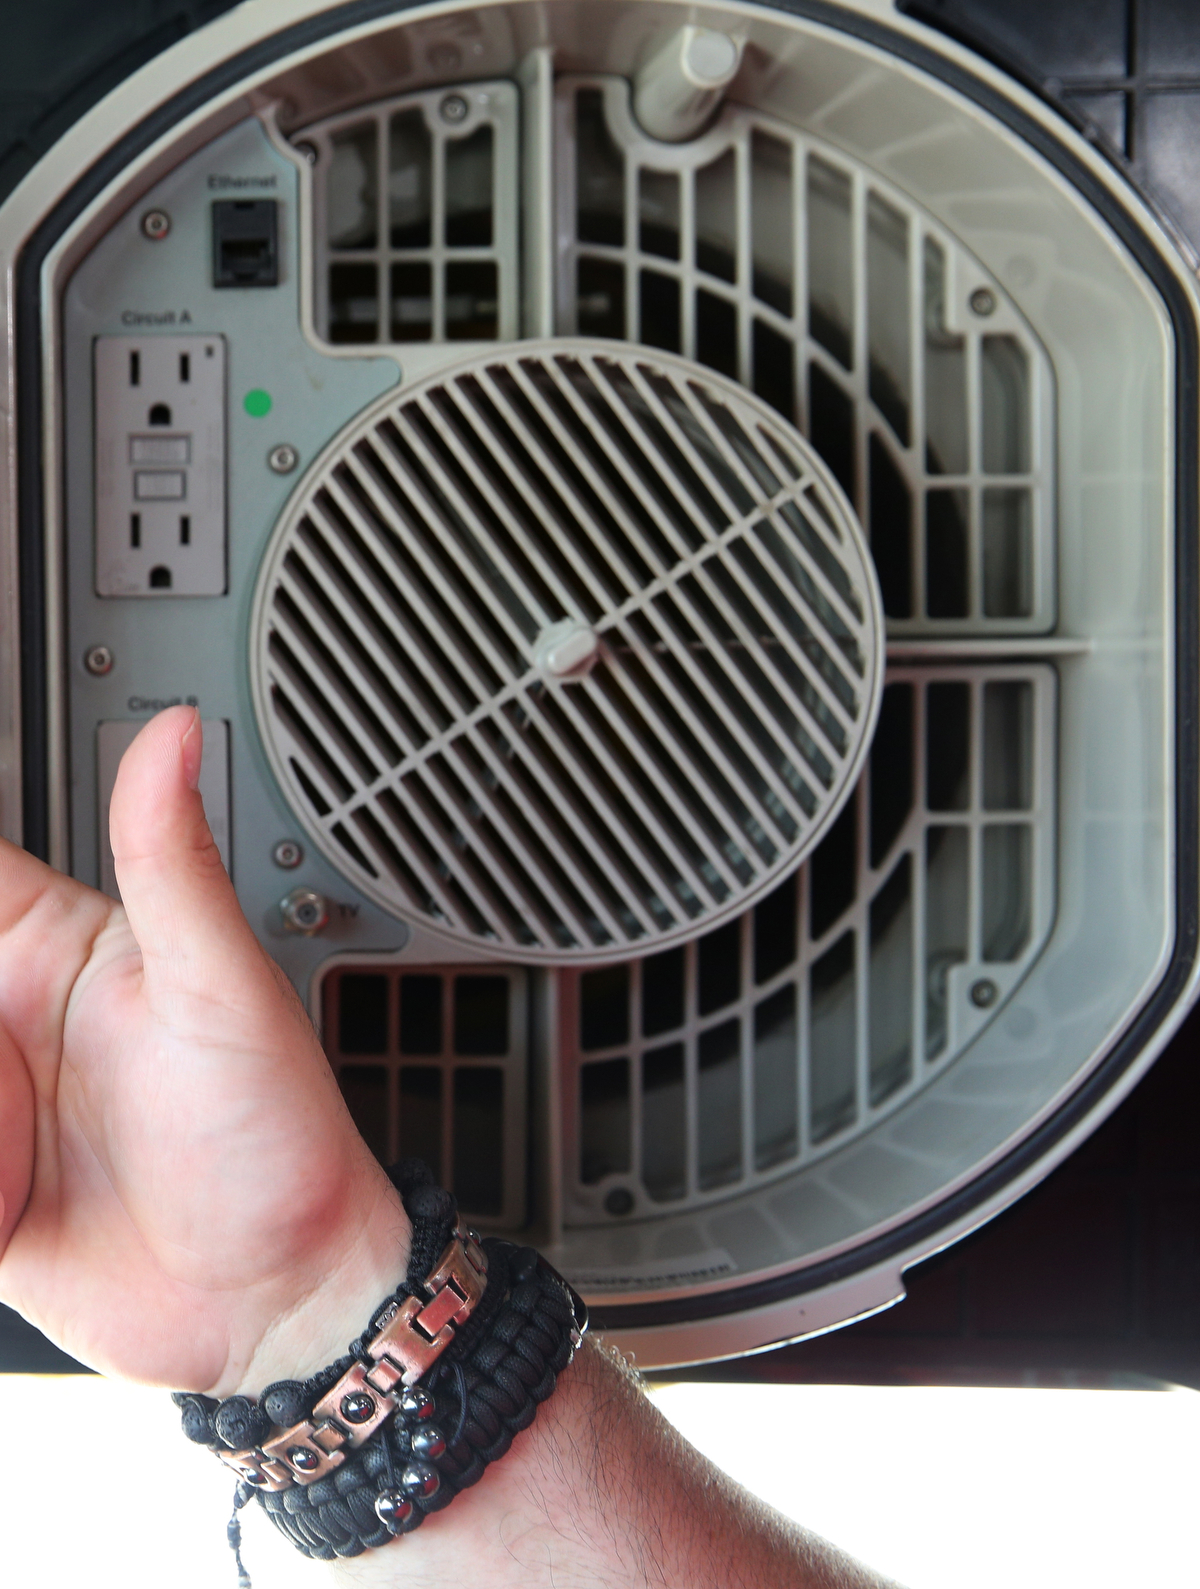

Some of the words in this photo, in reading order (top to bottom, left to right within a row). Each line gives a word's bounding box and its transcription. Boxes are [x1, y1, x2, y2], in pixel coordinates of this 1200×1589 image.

[208, 174, 277, 189] Ethernet
[121, 310, 175, 325] Circuit
[180, 310, 192, 323] A
